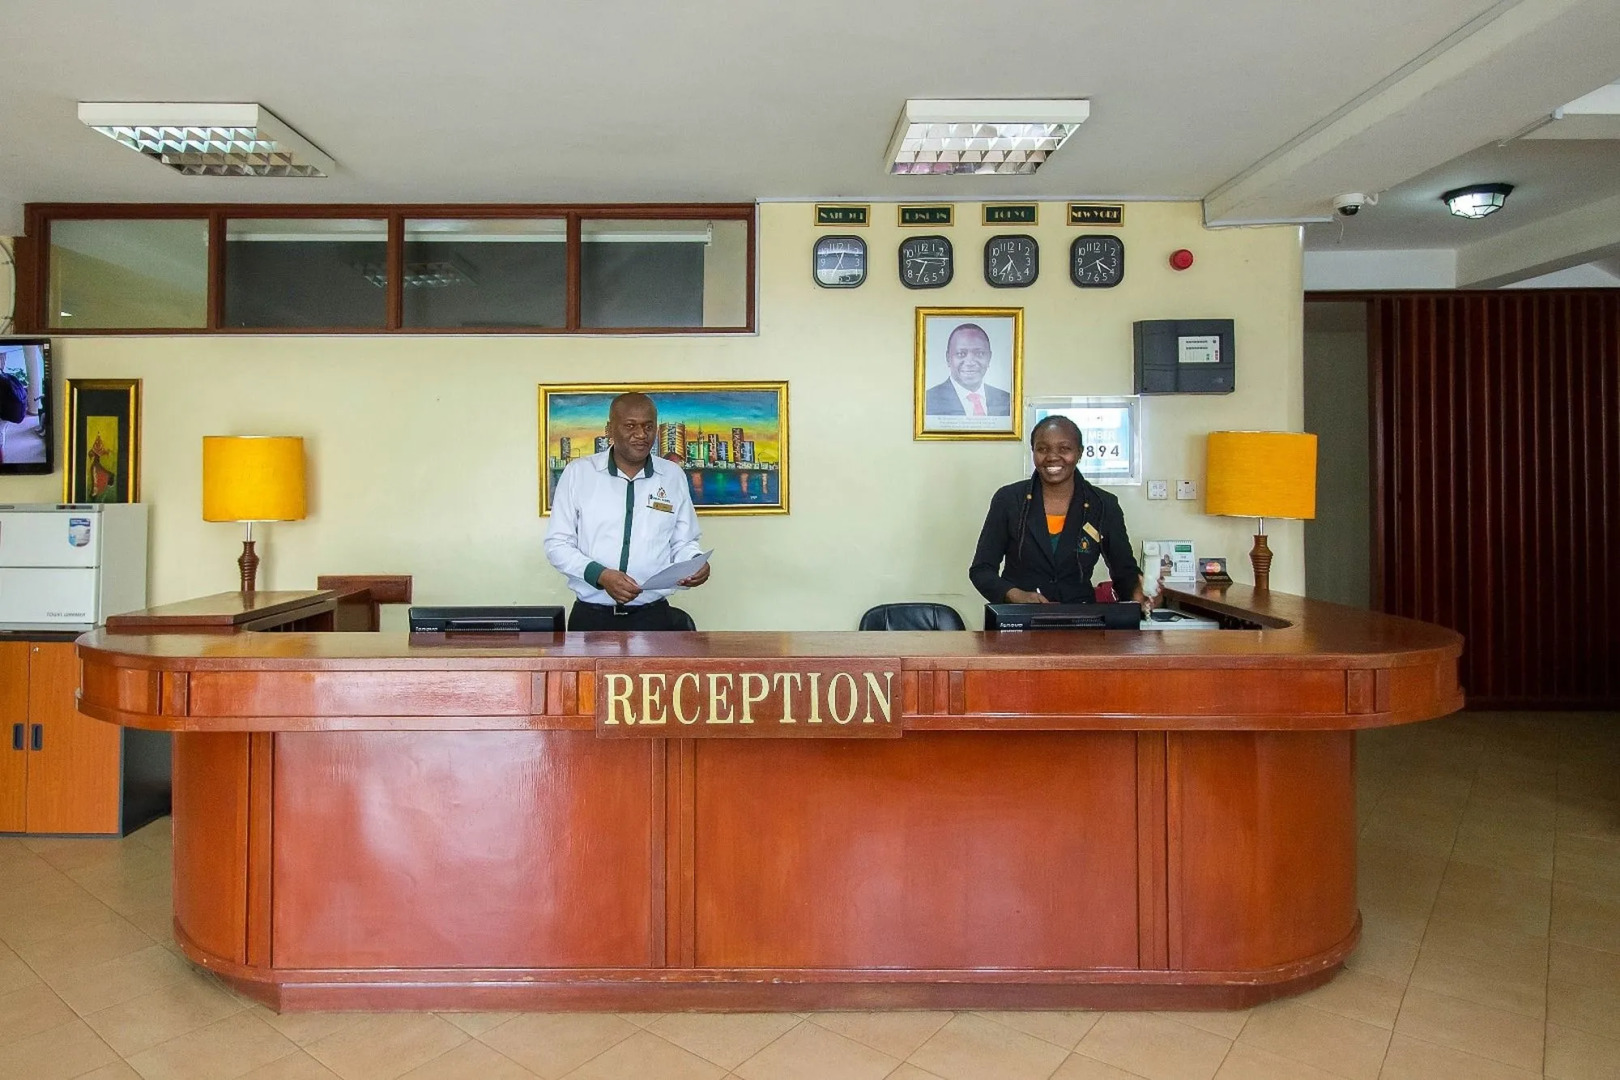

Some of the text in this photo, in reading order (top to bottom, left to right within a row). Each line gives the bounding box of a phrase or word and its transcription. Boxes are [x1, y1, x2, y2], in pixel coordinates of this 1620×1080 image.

[1072, 210, 1119, 218] NEW YORK
[1000, 243, 1006, 252] 11
[1007, 241, 1015, 251] 12
[1024, 246, 1030, 256] 2
[1086, 242, 1092, 252] 11
[1093, 241, 1101, 251] 12
[906, 249, 914, 258] 10
[992, 247, 1000, 257] 10
[1078, 247, 1086, 256] 10
[1110, 247, 1116, 257] 2
[820, 258, 826, 267] 9
[855, 258, 860, 267] 3
[905, 259, 912, 269] 9
[991, 257, 997, 267] 9
[1025, 257, 1031, 266] 3
[1077, 257, 1083, 267] 9
[1111, 257, 1117, 267] 3
[907, 269, 913, 279] 8
[938, 267, 945, 277] 4
[992, 267, 998, 277] 8
[1023, 267, 1029, 276] 4
[1078, 267, 1084, 277] 8
[1086, 272, 1092, 281] 7
[923, 273, 930, 283] 6
[932, 272, 938, 282] 5
[1008, 273, 1014, 282] 6
[1093, 273, 1100, 283] 6
[1102, 272, 1108, 282] 5
[604, 672, 895, 726] RECEPTION
